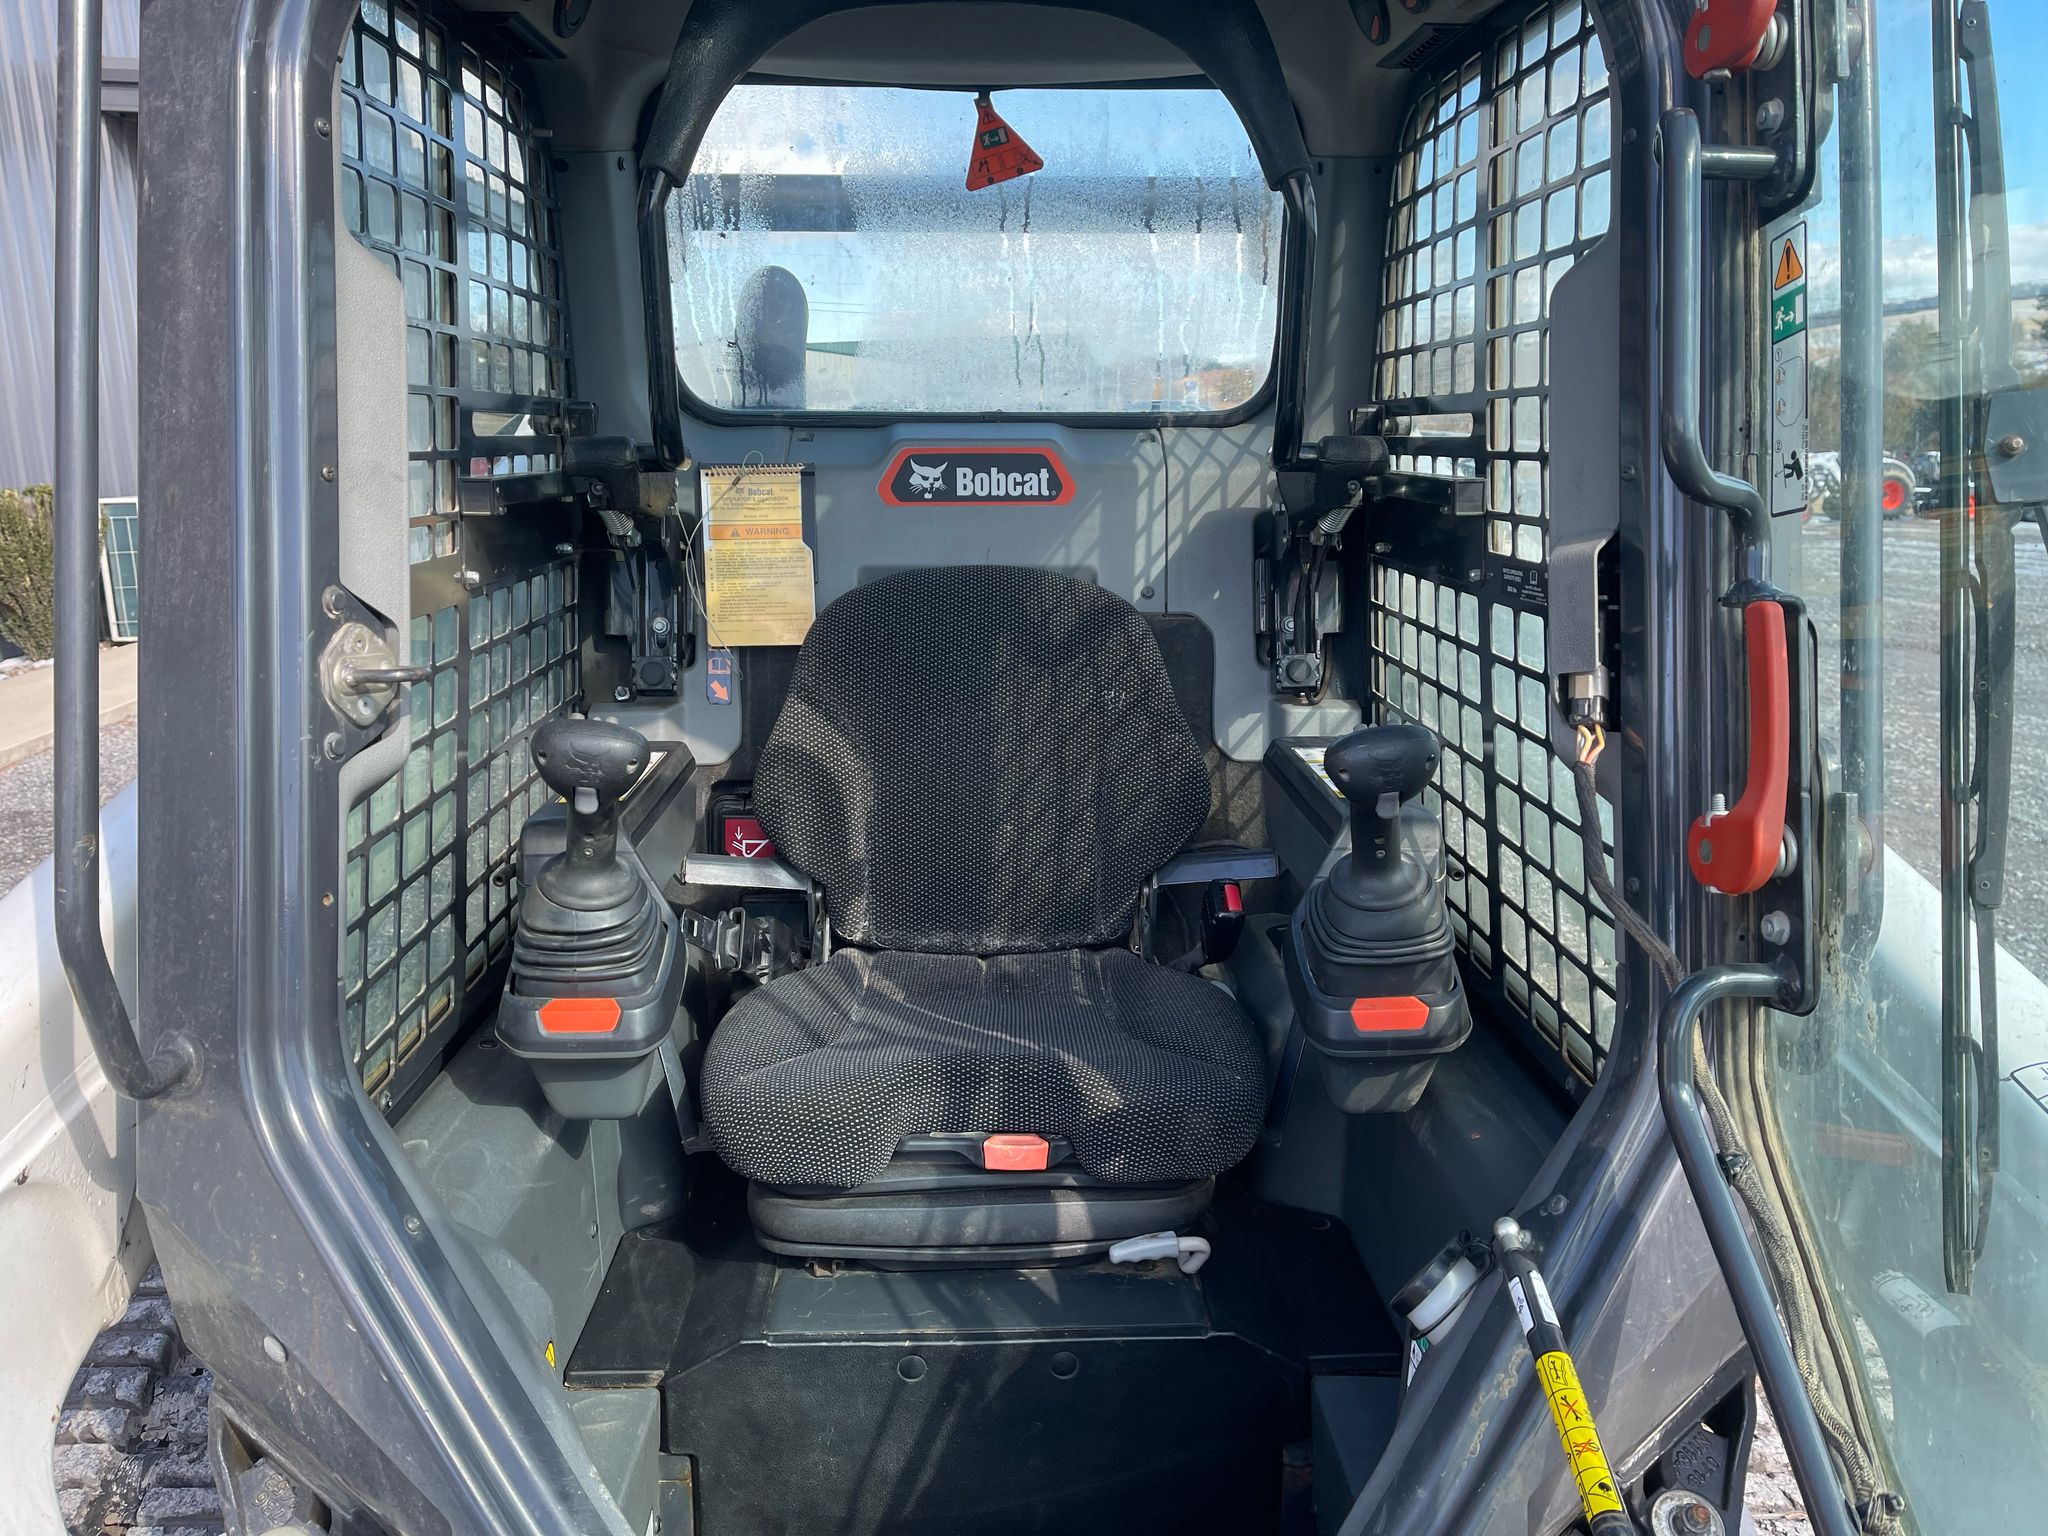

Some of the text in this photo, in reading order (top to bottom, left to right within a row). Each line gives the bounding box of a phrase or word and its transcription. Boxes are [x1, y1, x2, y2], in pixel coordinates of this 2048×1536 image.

[956, 467, 1050, 497] Bobcat
[747, 487, 774, 496] Bobcat
[745, 527, 790, 536] WARNING
